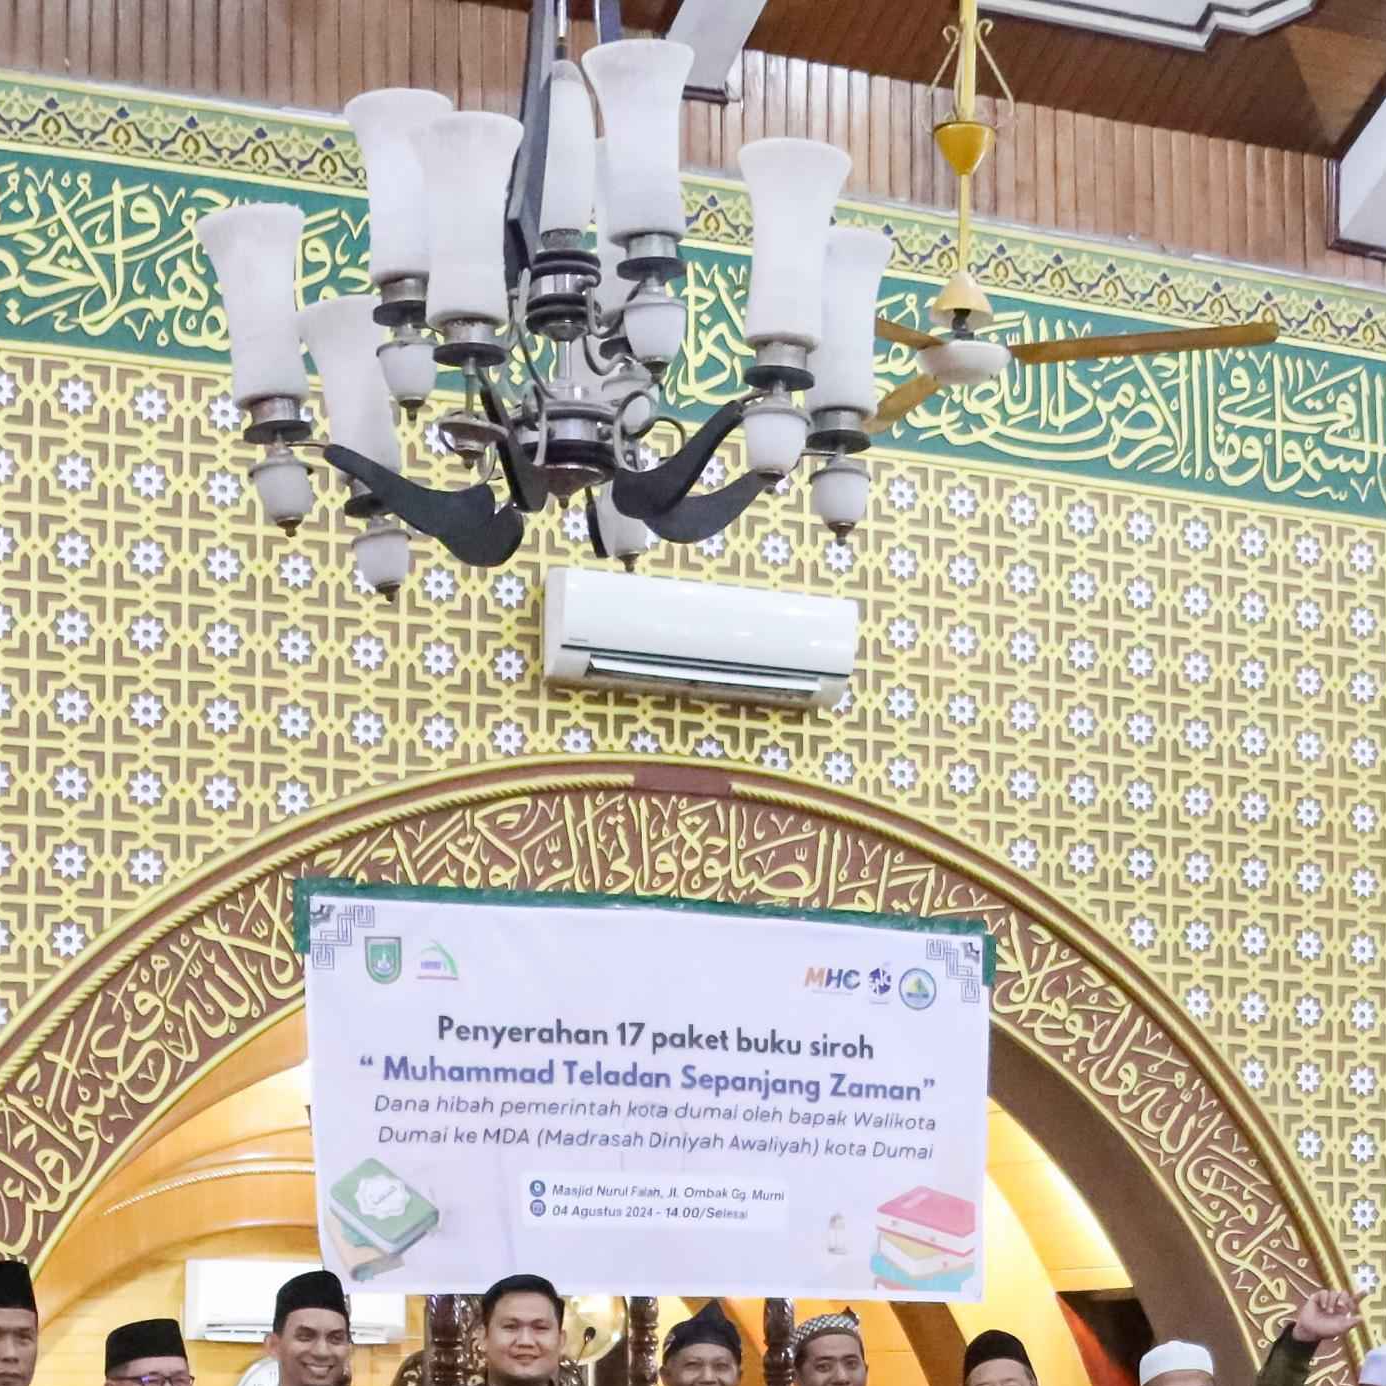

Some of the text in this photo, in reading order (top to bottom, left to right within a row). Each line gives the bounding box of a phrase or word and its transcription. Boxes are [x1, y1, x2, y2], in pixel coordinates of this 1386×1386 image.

[805, 967, 861, 990] MHC
[437, 1015, 874, 1059] Penyerahan 17 paket buku siroh
[383, 1055, 555, 1085] Muhammad
[562, 1060, 671, 1089] Teladan
[680, 1065, 821, 1103] Sepanjang
[374, 1094, 936, 1131] Dana hibah pemerintah kota dumai oleh bapak Walikota
[378, 1125, 934, 1160] Dumai ke MDA (Madrasah Diniyah Awaliyah) kota Dumai
[552, 1184, 594, 1199] Masjid
[684, 1186, 728, 1199] Ombak
[752, 1189, 785, 1202] Murni
[552, 1204, 568, 1217] 04
[571, 1204, 623, 1219] Agustus
[625, 1205, 653, 1218] 2024
